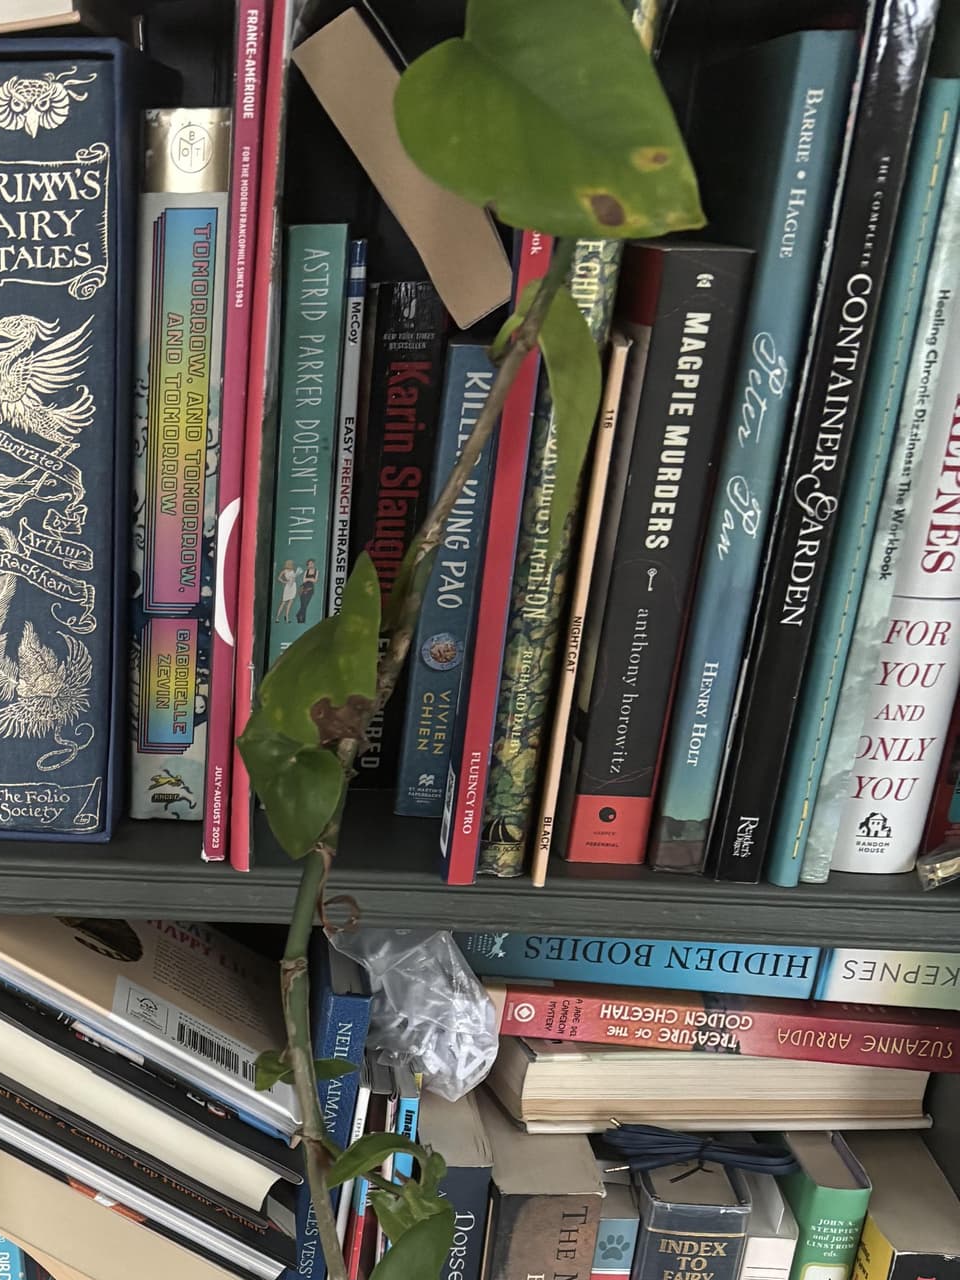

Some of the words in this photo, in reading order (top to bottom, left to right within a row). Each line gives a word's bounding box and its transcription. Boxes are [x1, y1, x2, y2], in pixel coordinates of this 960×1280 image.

[243, 9, 258, 119] FRANCE-AMÉRIQUE
[302, 249, 330, 321] ASTRID
[296, 334, 325, 408] PARKER
[680, 312, 711, 417] MAGPIE
[288, 419, 321, 497] DOESN'T
[645, 424, 692, 551] MURDERS
[288, 506, 314, 545] FAIL
[883, 619, 951, 646] FOR
[622, 608, 649, 688] anthony
[156, 654, 171, 710] ZEVIN
[174, 629, 190, 734] GABRIELLE
[876, 662, 946, 688] YOU
[416, 692, 435, 752] CHIEN
[435, 690, 452, 755] VIVIEN
[874, 704, 925, 722] AND
[610, 694, 639, 776] horowitz
[26, 790, 71, 806] Folio
[851, 776, 919, 801] YOU
[524, 936, 652, 968] BODIES
[665, 952, 816, 980] HIDDEN
[601, 1002, 678, 1021] CHEETAH
[682, 1012, 752, 1030] GOLDEN
[608, 1026, 629, 1038] THE
[634, 1028, 650, 1040] OF
[660, 1030, 738, 1048] TREASURE
[778, 1028, 852, 1046] ARRUDA
[862, 1036, 954, 1058] SUZANNE
[658, 1241, 726, 1260] INDEX
[676, 1255, 708, 1271] TO
